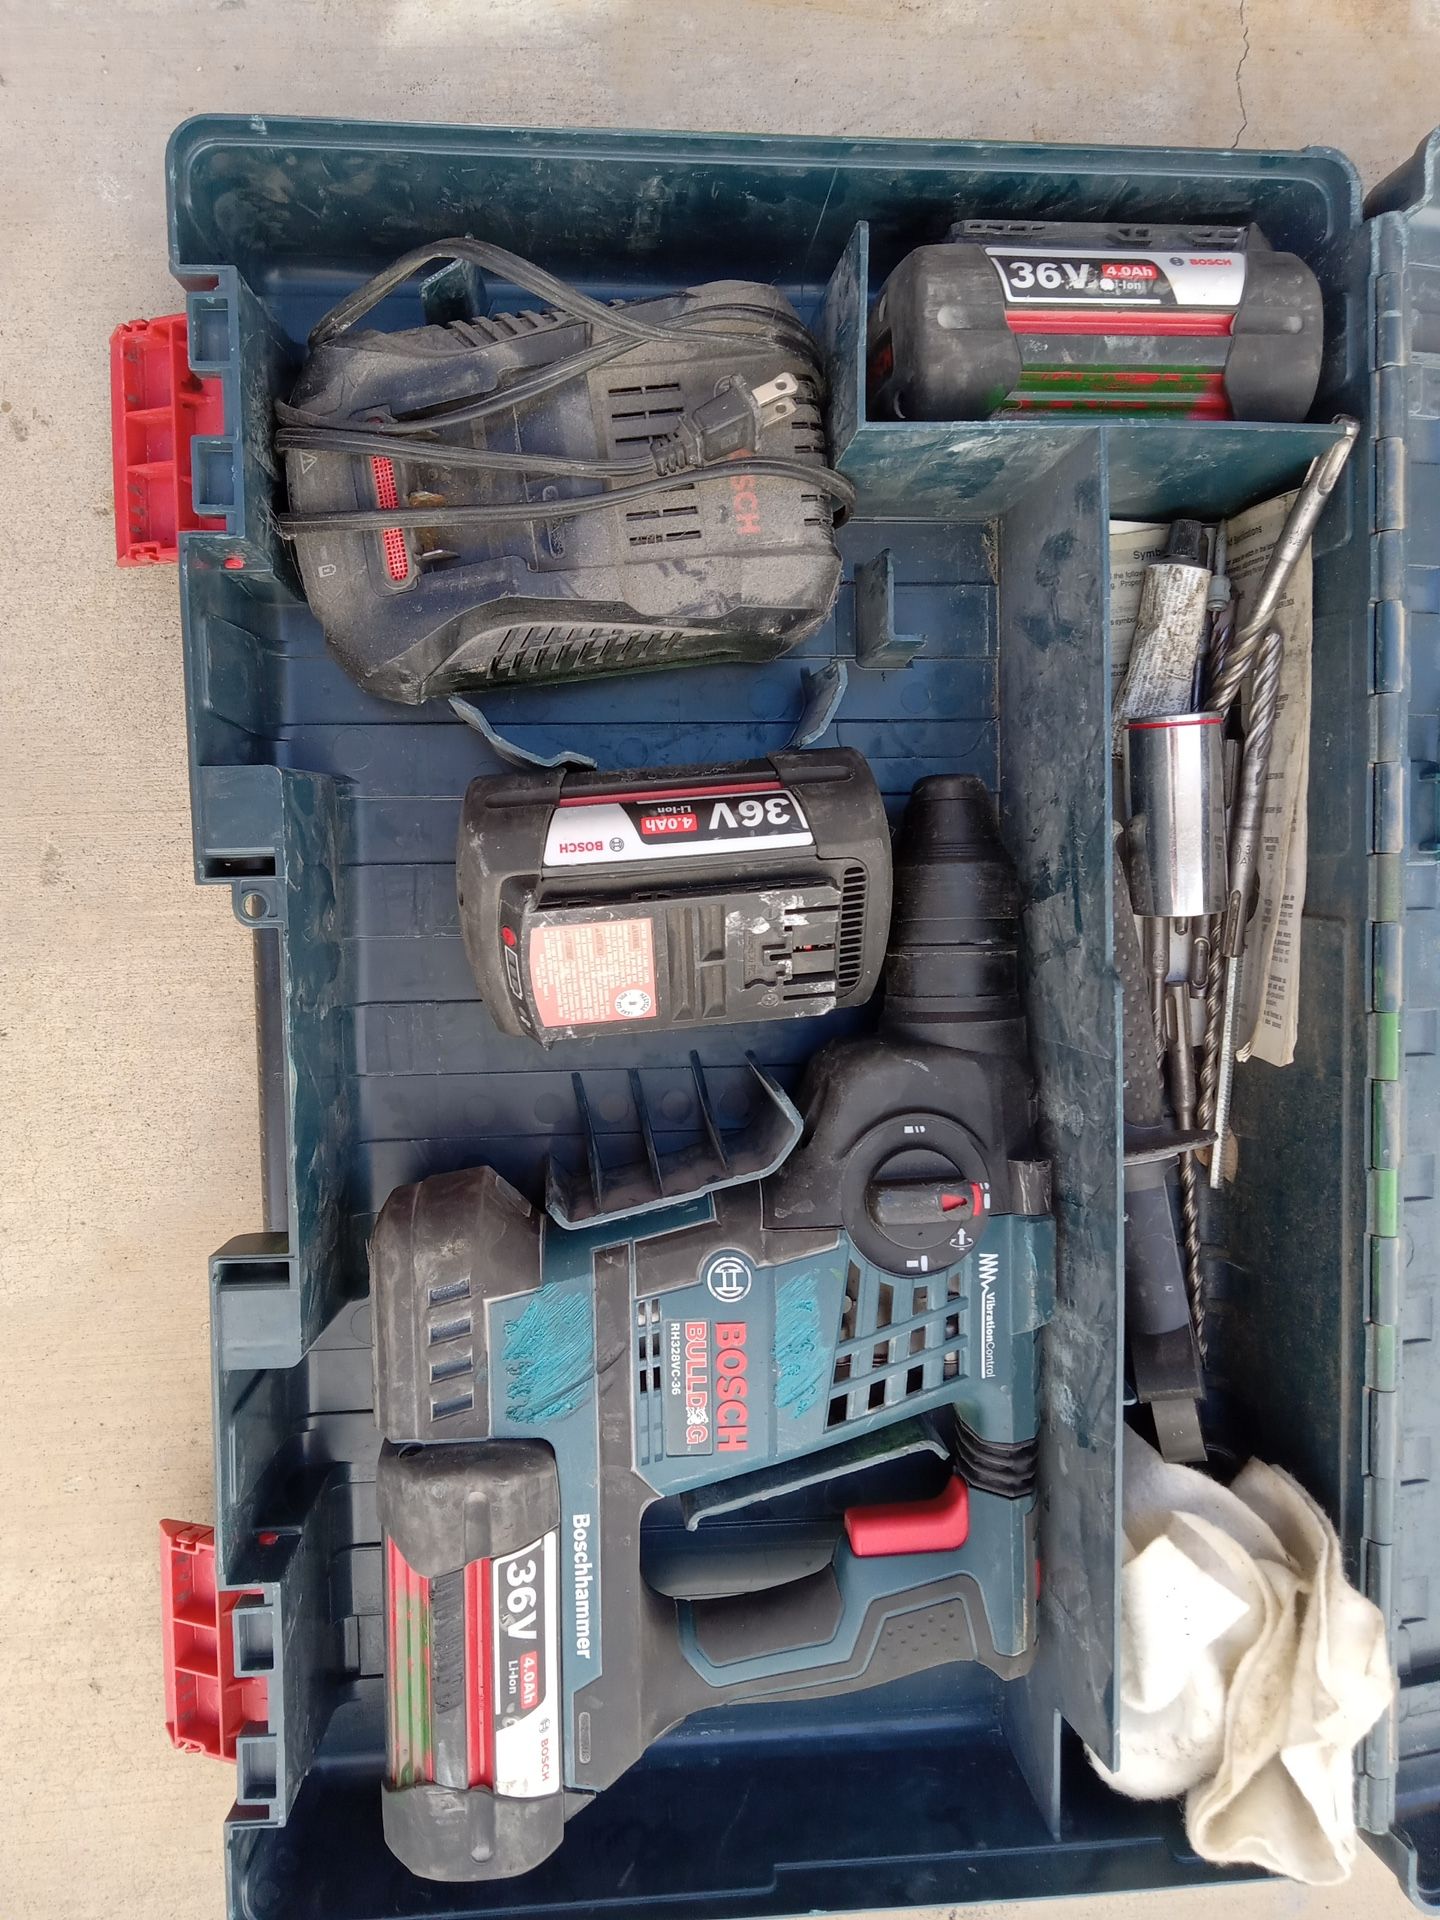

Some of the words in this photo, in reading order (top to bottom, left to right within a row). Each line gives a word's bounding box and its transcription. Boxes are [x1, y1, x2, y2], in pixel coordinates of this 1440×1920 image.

[1010, 261, 1090, 290] 36V
[1106, 265, 1153, 277] 4.0Ah
[1189, 258, 1232, 266] BOSCH
[1106, 280, 1142, 290] i-Ion
[730, 450, 761, 534] SCH
[1133, 548, 1162, 560] Symb
[1115, 617, 1137, 626] symbo
[645, 816, 693, 832] 4.0Ah
[658, 804, 692, 814] Li-Ion
[709, 798, 791, 829] 36V
[559, 840, 604, 854] BOSCH
[985, 1291, 996, 1378] VibrationControl
[670, 1322, 681, 1396] RH328VC-36
[685, 1321, 709, 1445] BULLDG
[715, 1321, 749, 1452] BOSCH
[506, 1559, 538, 1640] 36V
[572, 1513, 591, 1660] Boschhammer
[508, 1660, 519, 1694] Li-Ion
[522, 1657, 536, 1705] 4.0Ah
[540, 1738, 549, 1782] BOSCH
